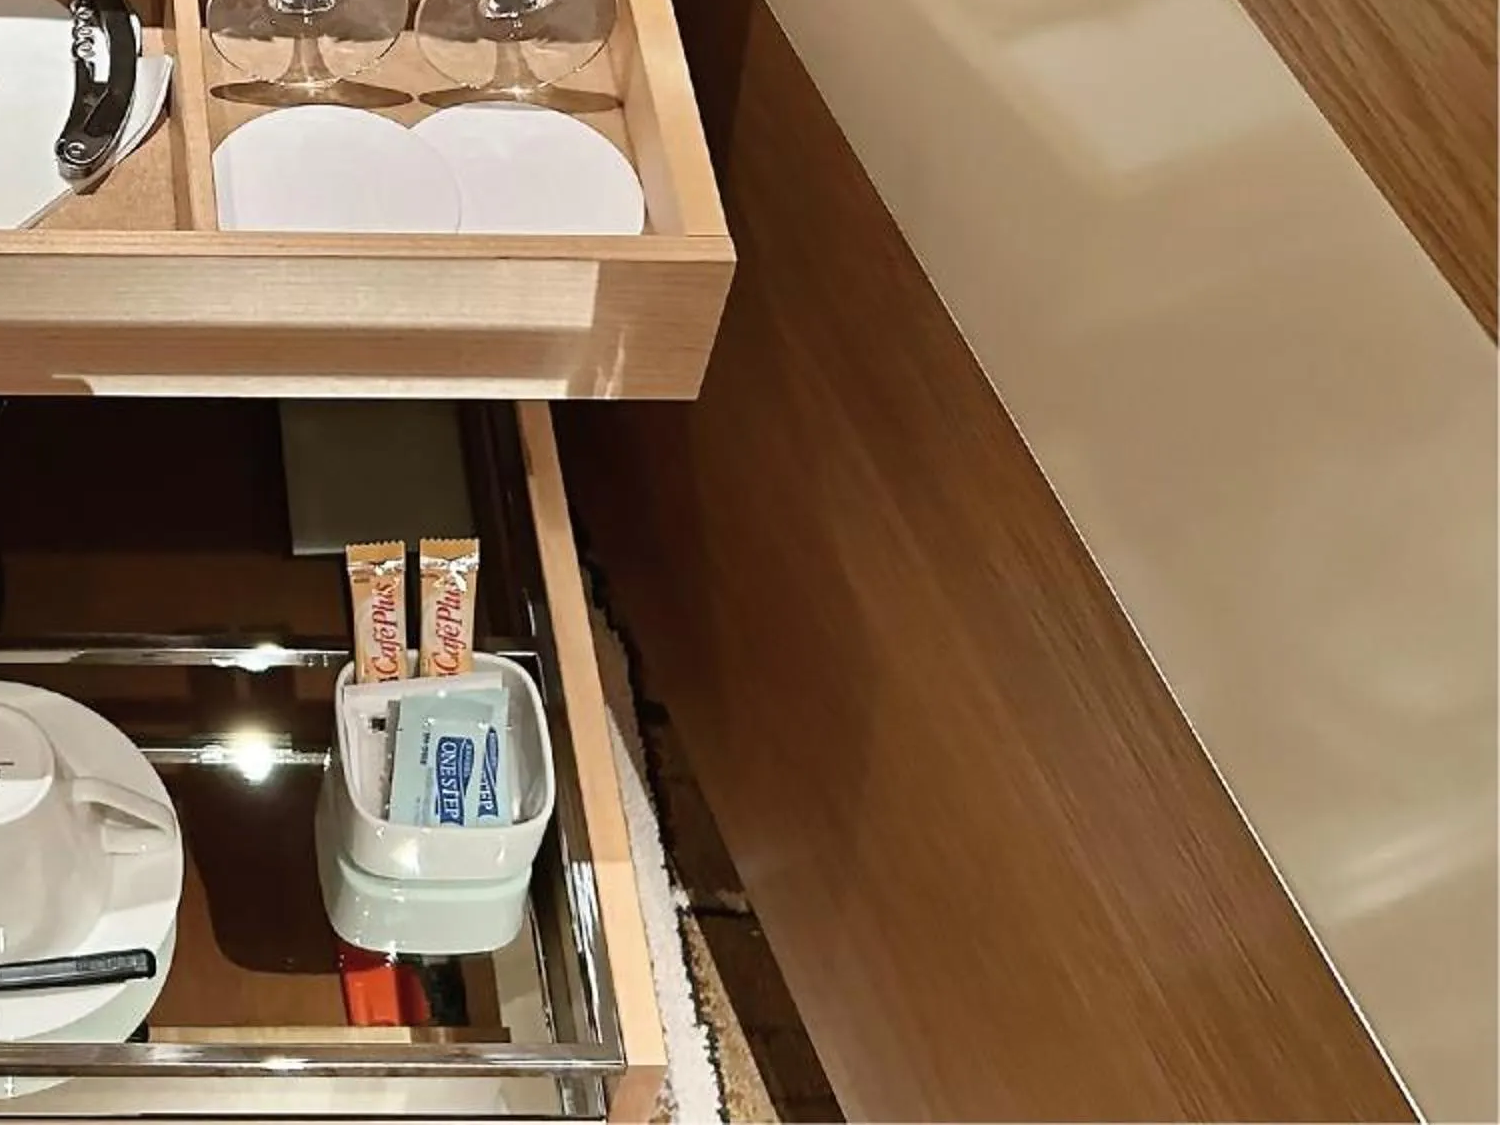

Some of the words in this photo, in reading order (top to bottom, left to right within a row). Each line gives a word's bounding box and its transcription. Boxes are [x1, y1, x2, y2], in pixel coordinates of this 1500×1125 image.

[433, 581, 466, 672] CaféPlu
[440, 741, 457, 777] ONE
[441, 777, 460, 820] STEP
